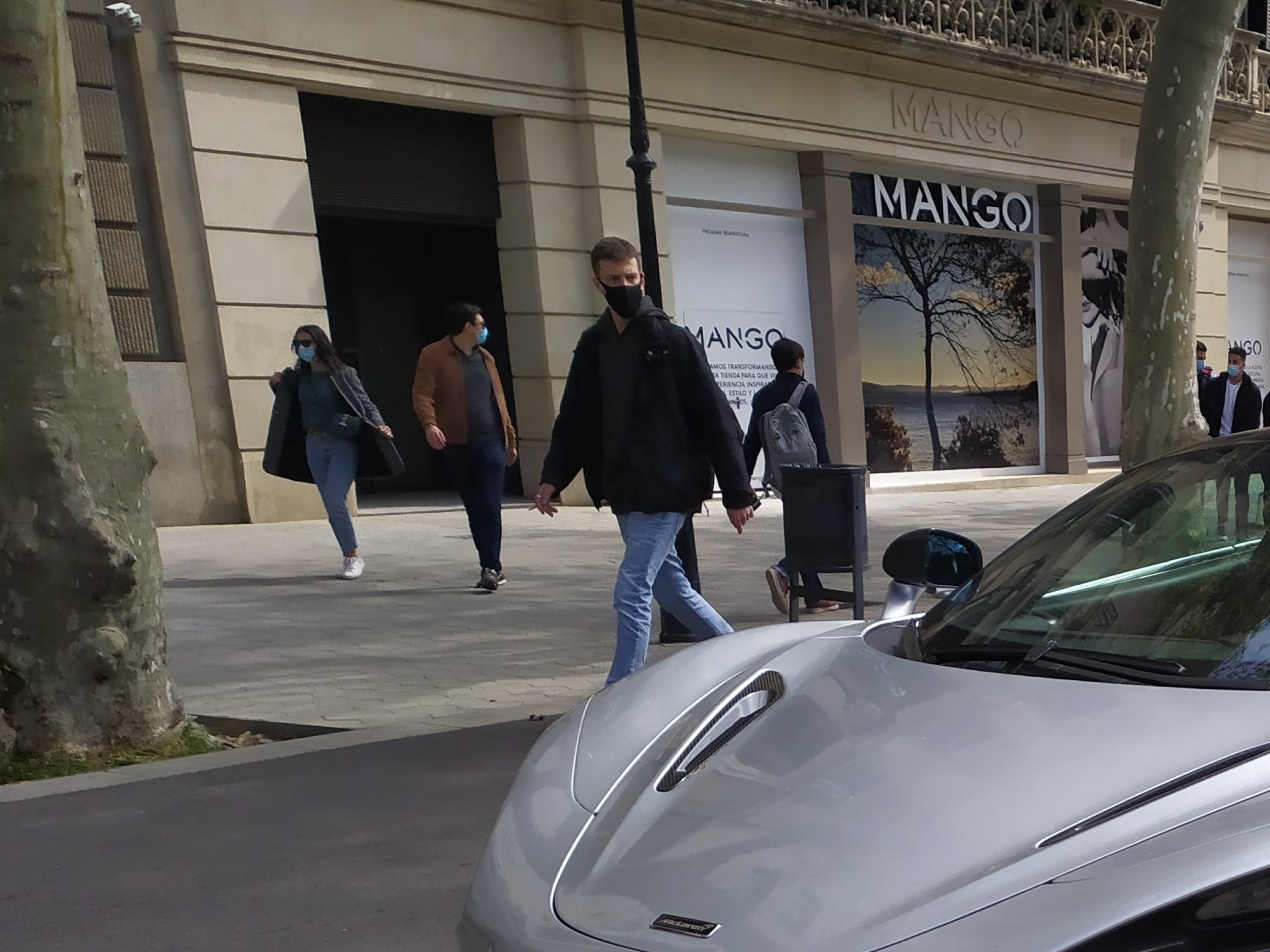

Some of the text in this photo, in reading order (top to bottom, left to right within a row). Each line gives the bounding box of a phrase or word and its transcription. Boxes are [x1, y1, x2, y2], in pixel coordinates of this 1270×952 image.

[891, 90, 1023, 148] MANGO
[873, 174, 1032, 232] MANGO
[685, 325, 783, 350] MANGO
[1228, 339, 1262, 356] ANGO
